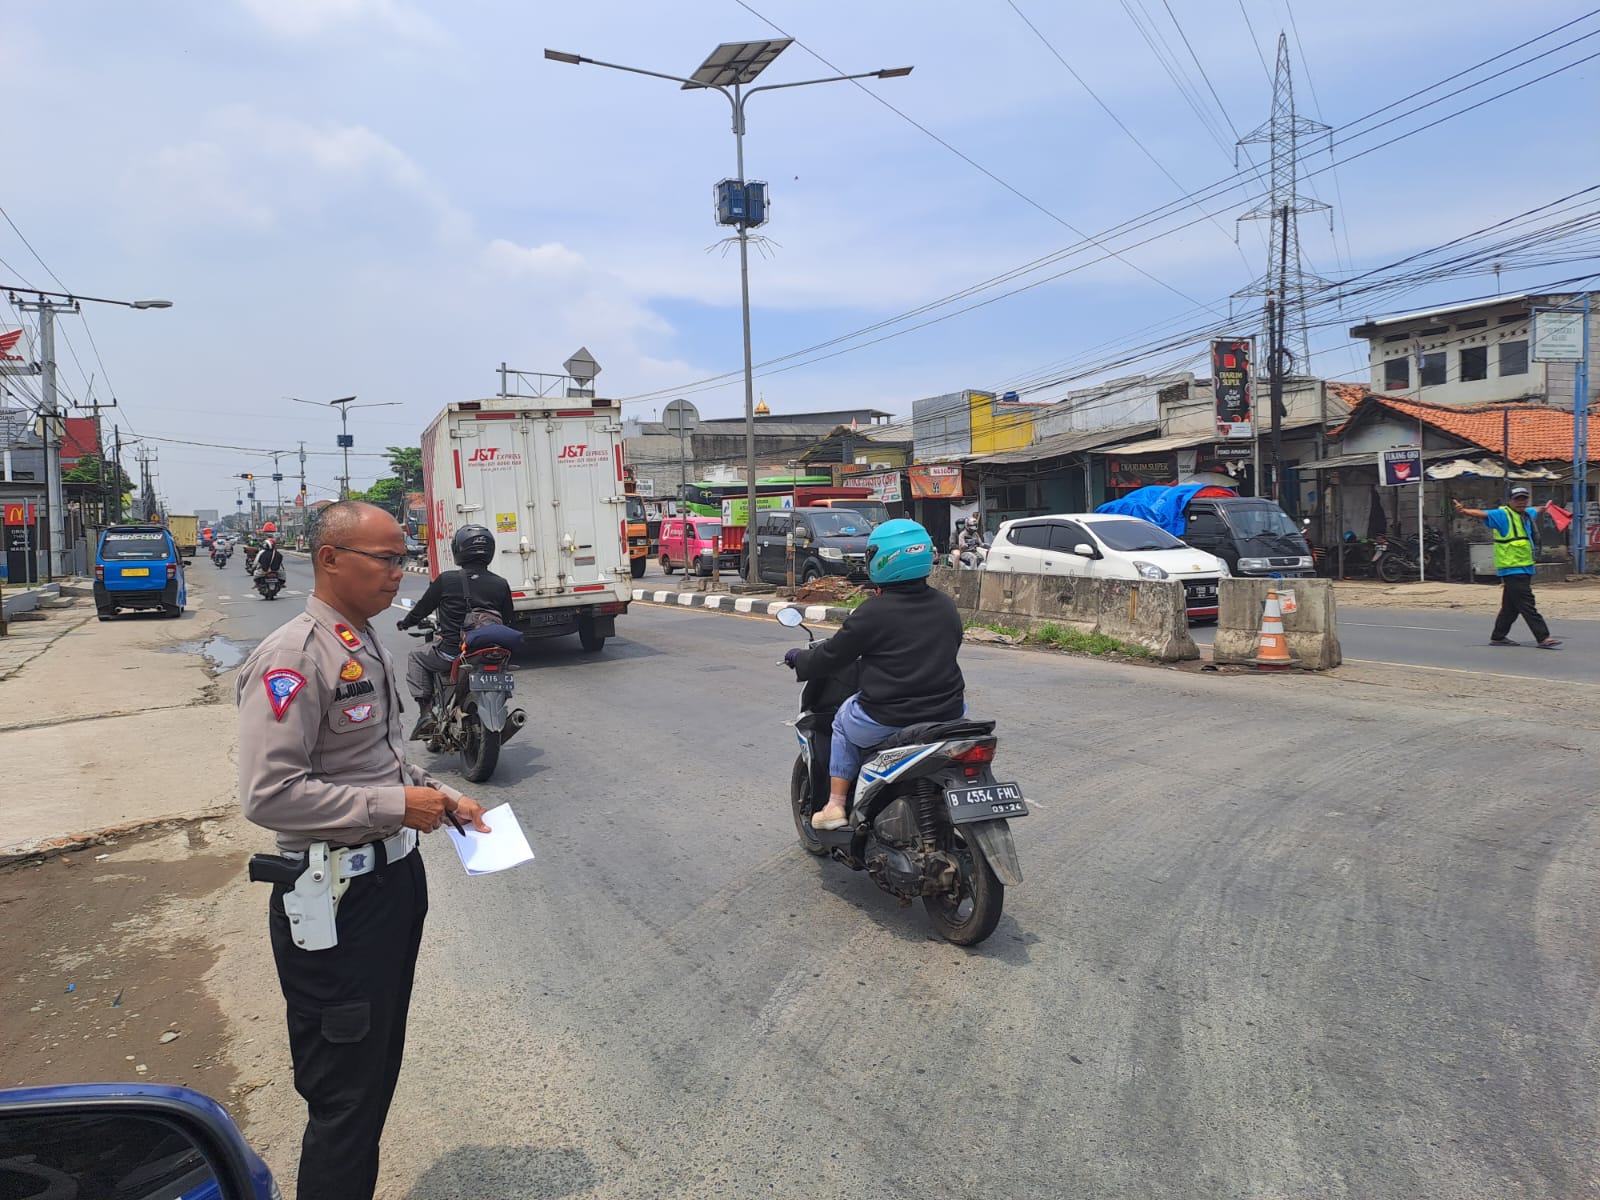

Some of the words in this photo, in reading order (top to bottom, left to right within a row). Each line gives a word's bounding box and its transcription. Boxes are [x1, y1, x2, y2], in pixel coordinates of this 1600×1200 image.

[468, 447, 501, 462] J&T
[558, 444, 589, 459] J&T
[950, 793, 959, 806] B
[966, 789, 993, 804] 4554
[997, 786, 1020, 800] FHL
